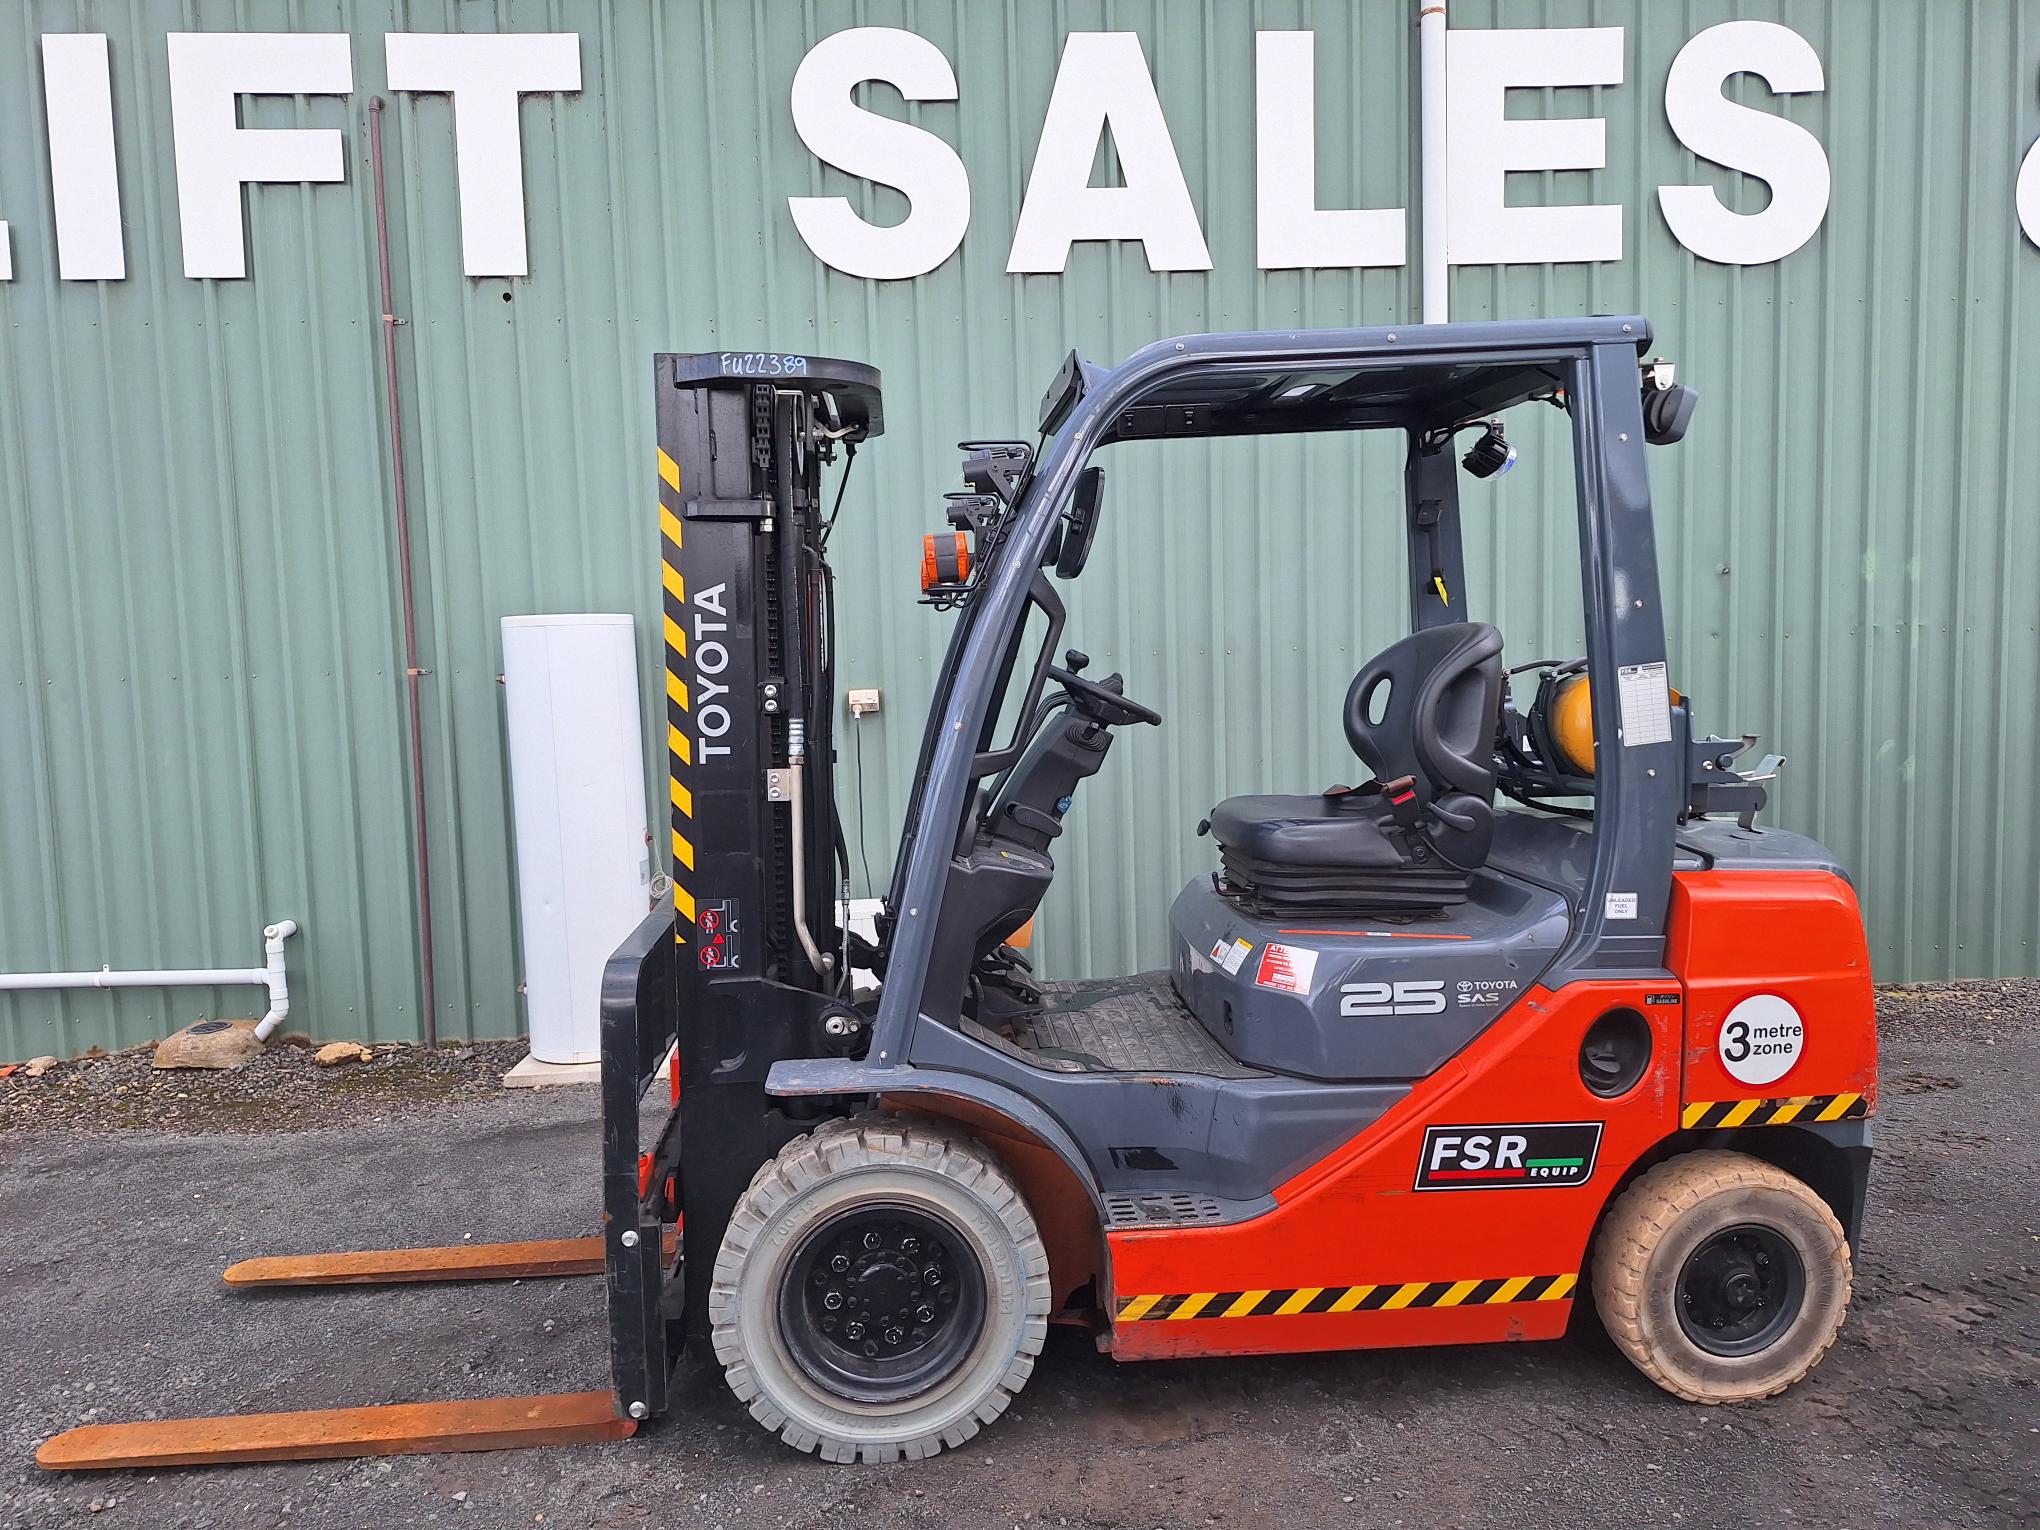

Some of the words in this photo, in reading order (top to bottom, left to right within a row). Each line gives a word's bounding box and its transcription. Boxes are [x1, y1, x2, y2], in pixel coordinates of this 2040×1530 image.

[0, 31, 582, 281] IFT
[787, 20, 1832, 281] SALES
[693, 582, 731, 765] TOYOTA
[1340, 980, 1447, 1017] 25
[1457, 992, 1499, 1003] SAS
[1474, 980, 1518, 991] TOYOTA
[1724, 1021, 1751, 1062] 3
[1753, 1023, 1802, 1039] metre
[1752, 1042, 1793, 1055] zone
[1430, 1135, 1528, 1171] FSR
[1530, 1167, 1579, 1178] EQUIP
